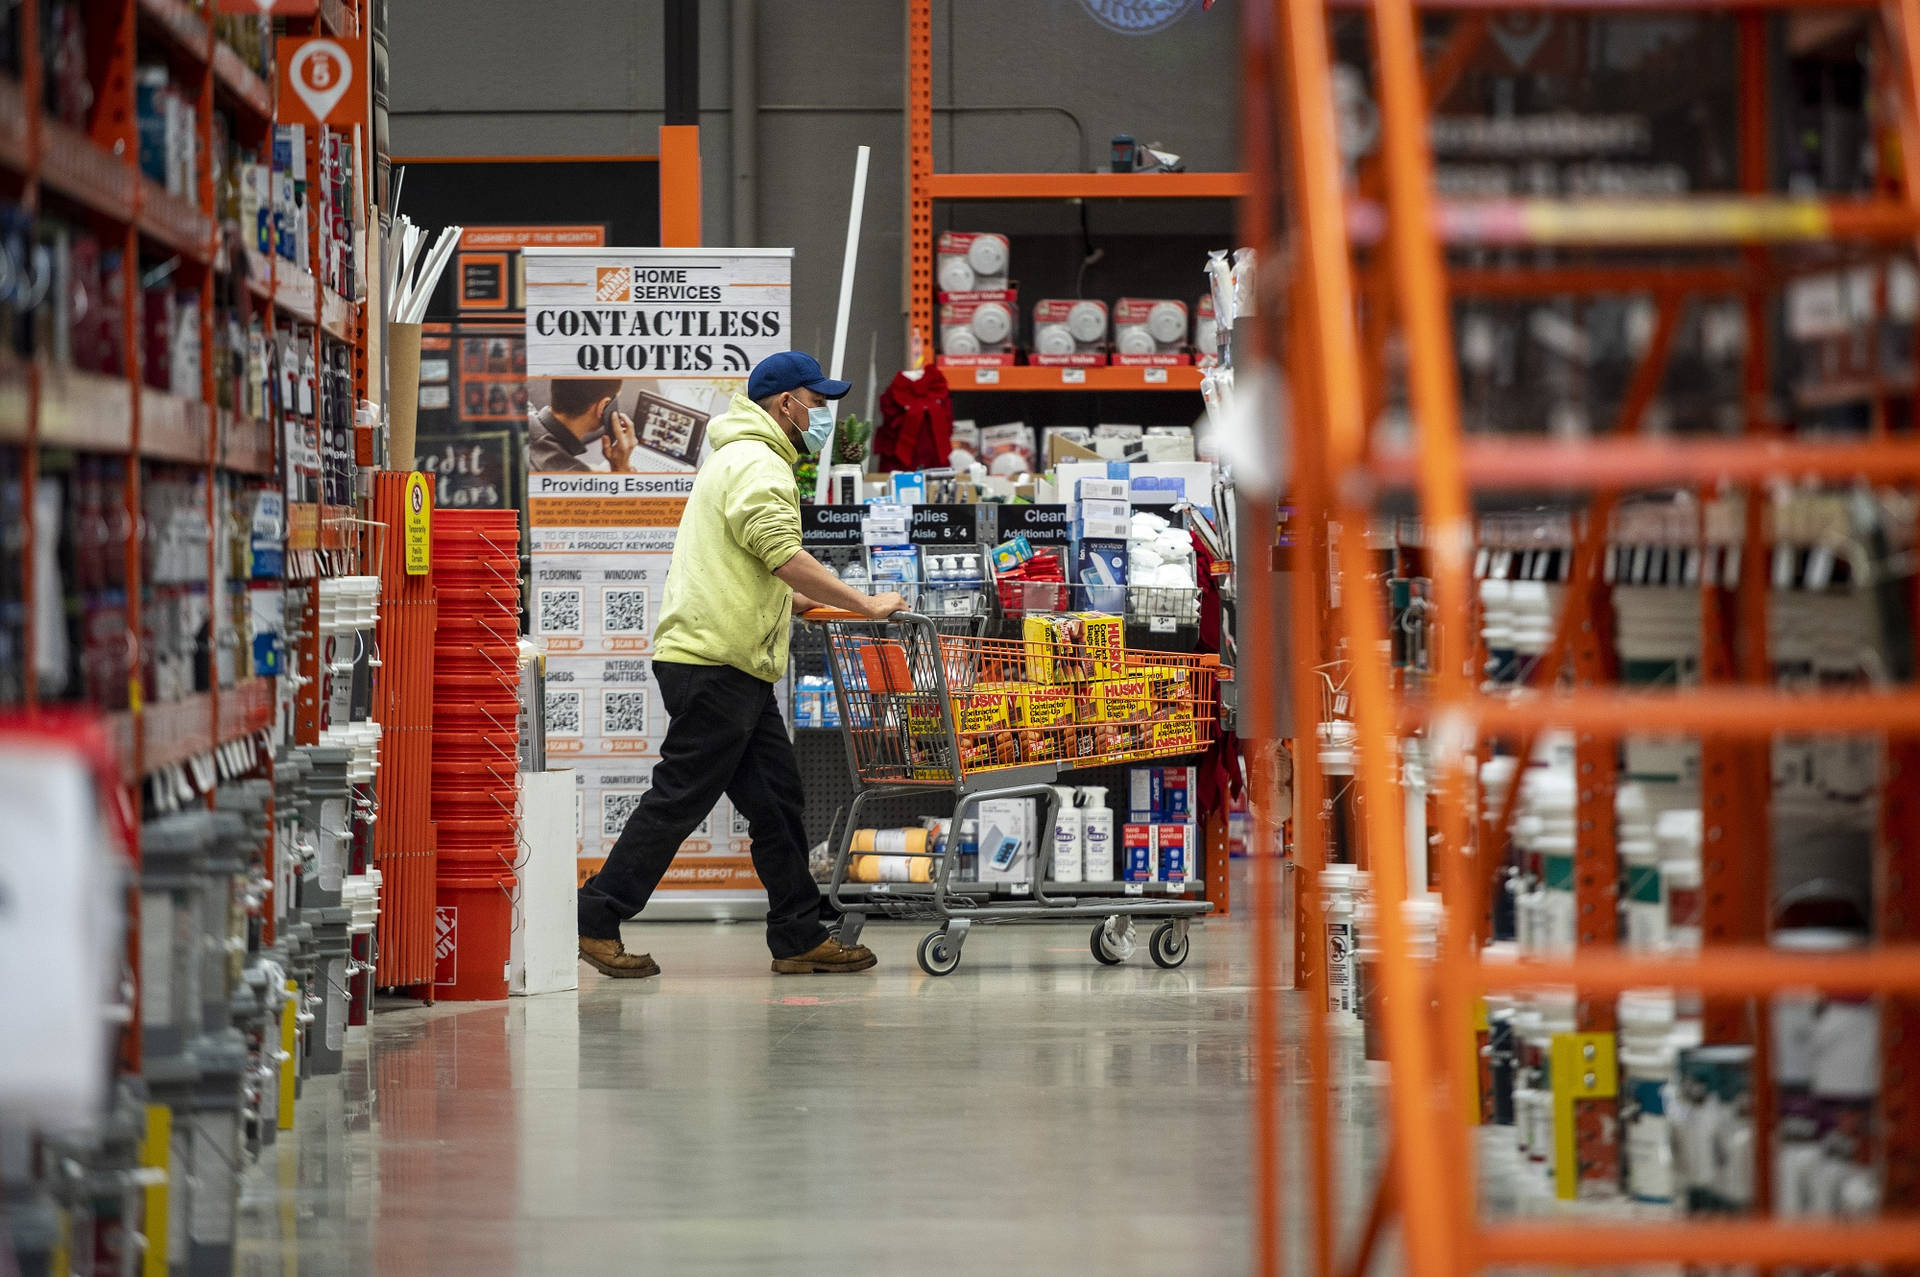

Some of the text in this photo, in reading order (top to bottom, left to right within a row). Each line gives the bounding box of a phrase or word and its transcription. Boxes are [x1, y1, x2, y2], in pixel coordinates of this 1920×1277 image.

[533, 232, 553, 242] THE
[556, 231, 596, 241] MONTH
[634, 270, 687, 283] HOME
[634, 285, 721, 300] SERVICES
[535, 309, 781, 338] CONTACTLESS
[577, 344, 714, 372] QUOTES
[1038, 355, 1096, 365] Special Value
[1120, 356, 1177, 366] Special Value
[414, 445, 485, 475] redit
[542, 478, 693, 494] Providing Essentia
[566, 500, 600, 508] providing
[610, 518, 652, 526] responding
[559, 531, 576, 540] GET
[623, 531, 646, 540] SCAN
[804, 530, 847, 539] dditional
[912, 529, 937, 538] Aisle
[1003, 529, 1054, 538] Additional
[540, 570, 582, 580] FLOORING
[604, 570, 647, 580] WINDOWS
[615, 639, 634, 649] SCAN
[1108, 623, 1121, 674] HUSKY
[605, 660, 645, 670] INTERIOR
[546, 672, 574, 681] SHEDS
[603, 672, 647, 681] SHUTTERS
[1105, 683, 1144, 697] HUSKY
[601, 776, 650, 784] COUNTERTOPS
[698, 869, 734, 879] DEPOT
